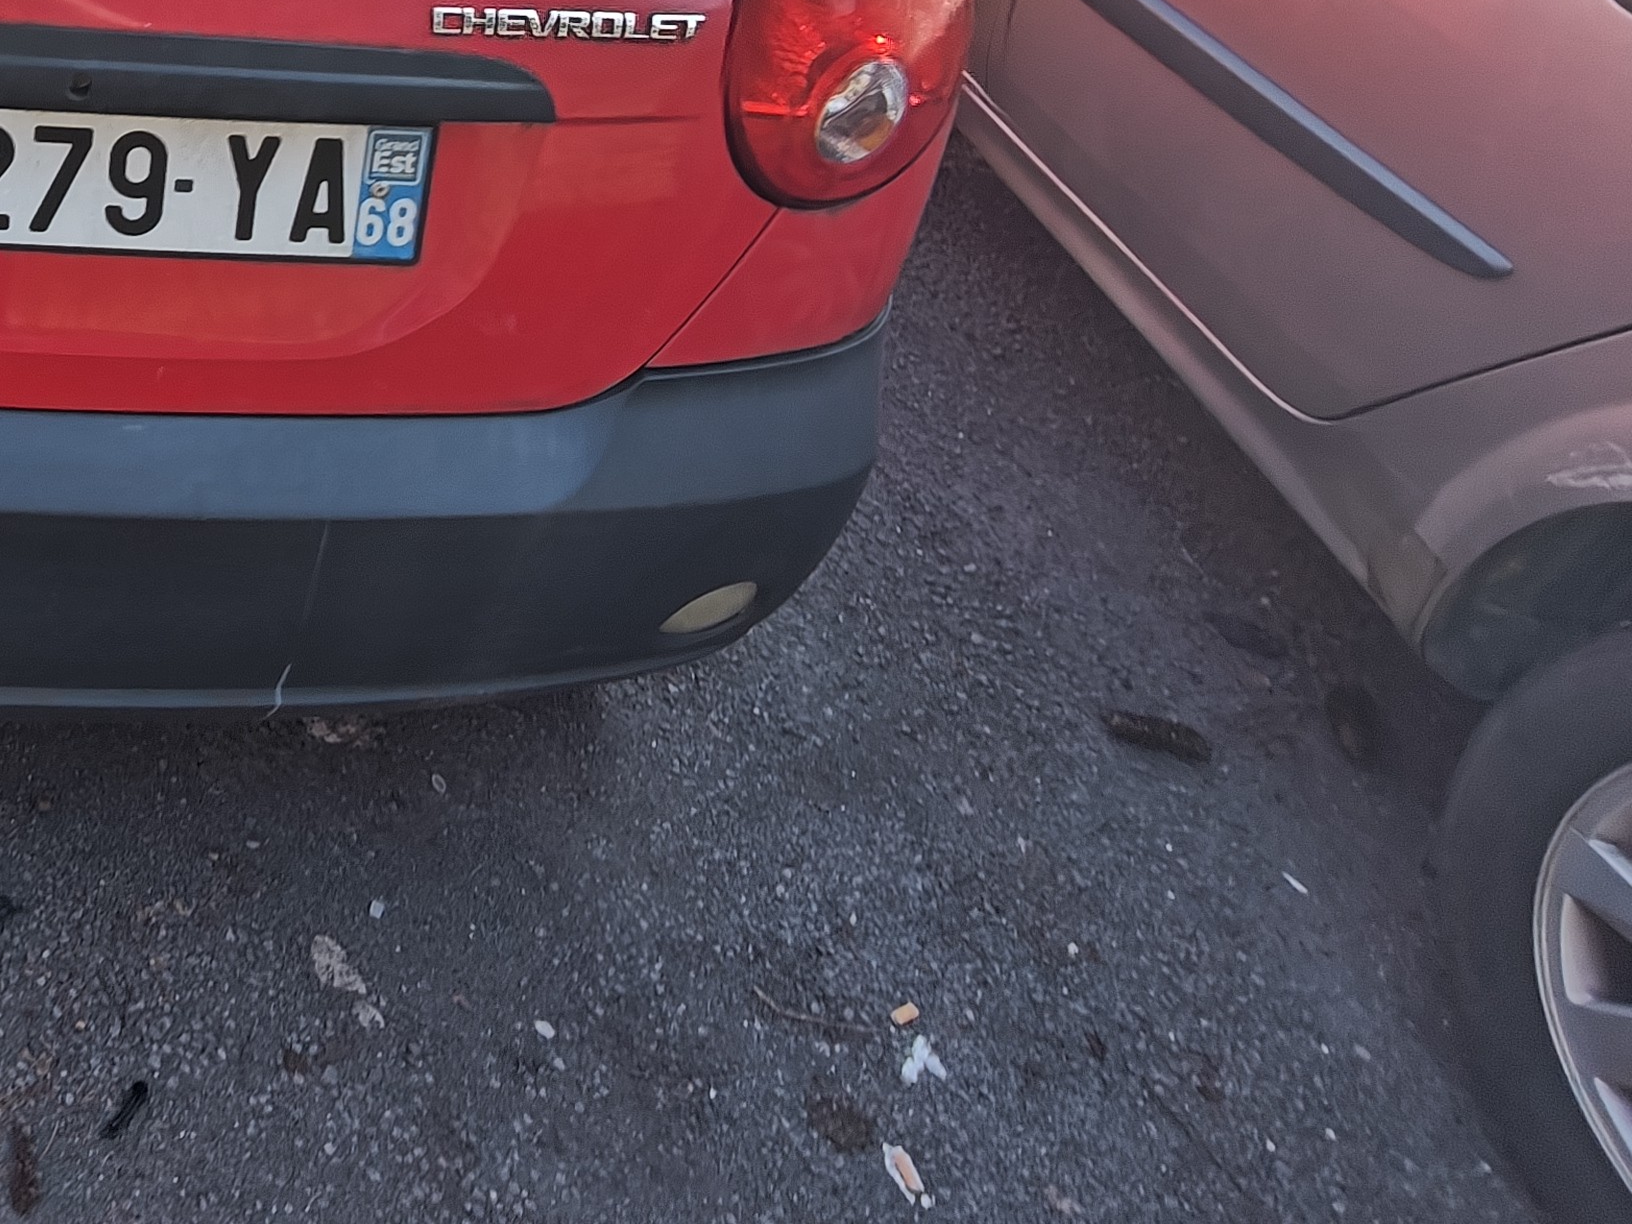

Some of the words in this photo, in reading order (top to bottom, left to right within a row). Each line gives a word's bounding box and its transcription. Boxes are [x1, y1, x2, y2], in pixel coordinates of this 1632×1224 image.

[432, 6, 707, 40] CHEVROLET
[371, 151, 417, 174] Est
[356, 197, 418, 247] 68
